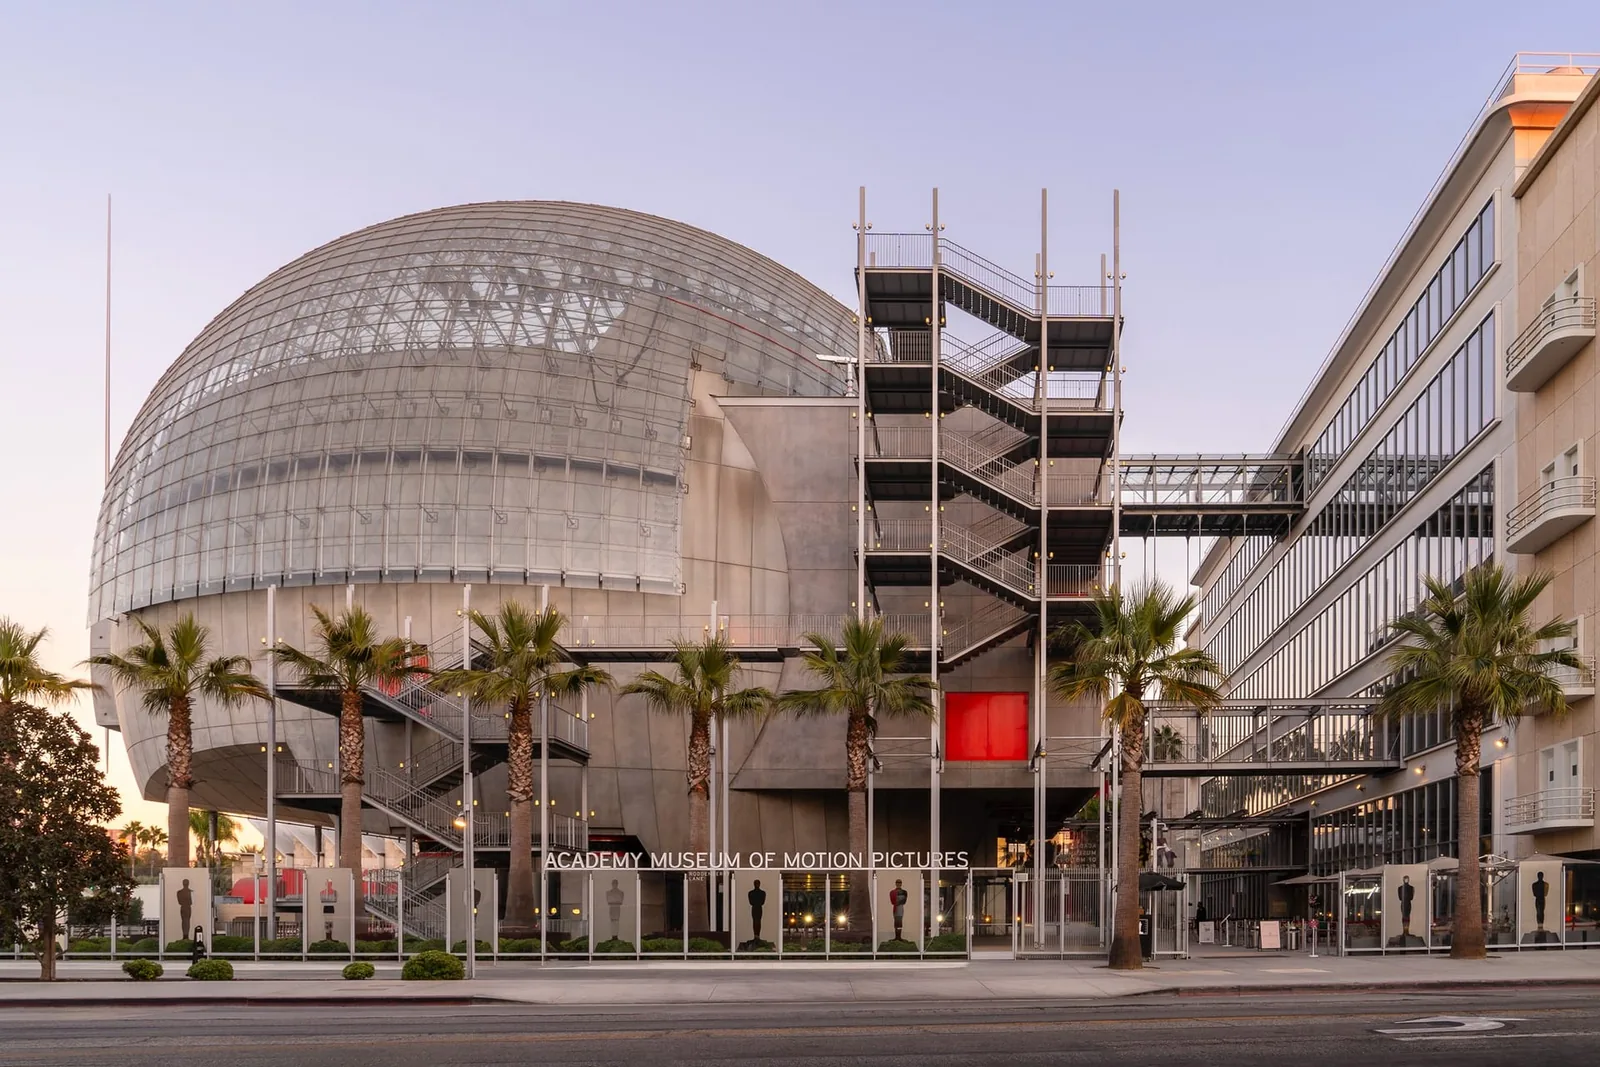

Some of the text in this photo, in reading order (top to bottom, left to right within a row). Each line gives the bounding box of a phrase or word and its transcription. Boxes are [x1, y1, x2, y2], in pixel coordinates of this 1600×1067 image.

[544, 852, 969, 868] ACADEMY MUSEUM OF MOTION PICTURES
